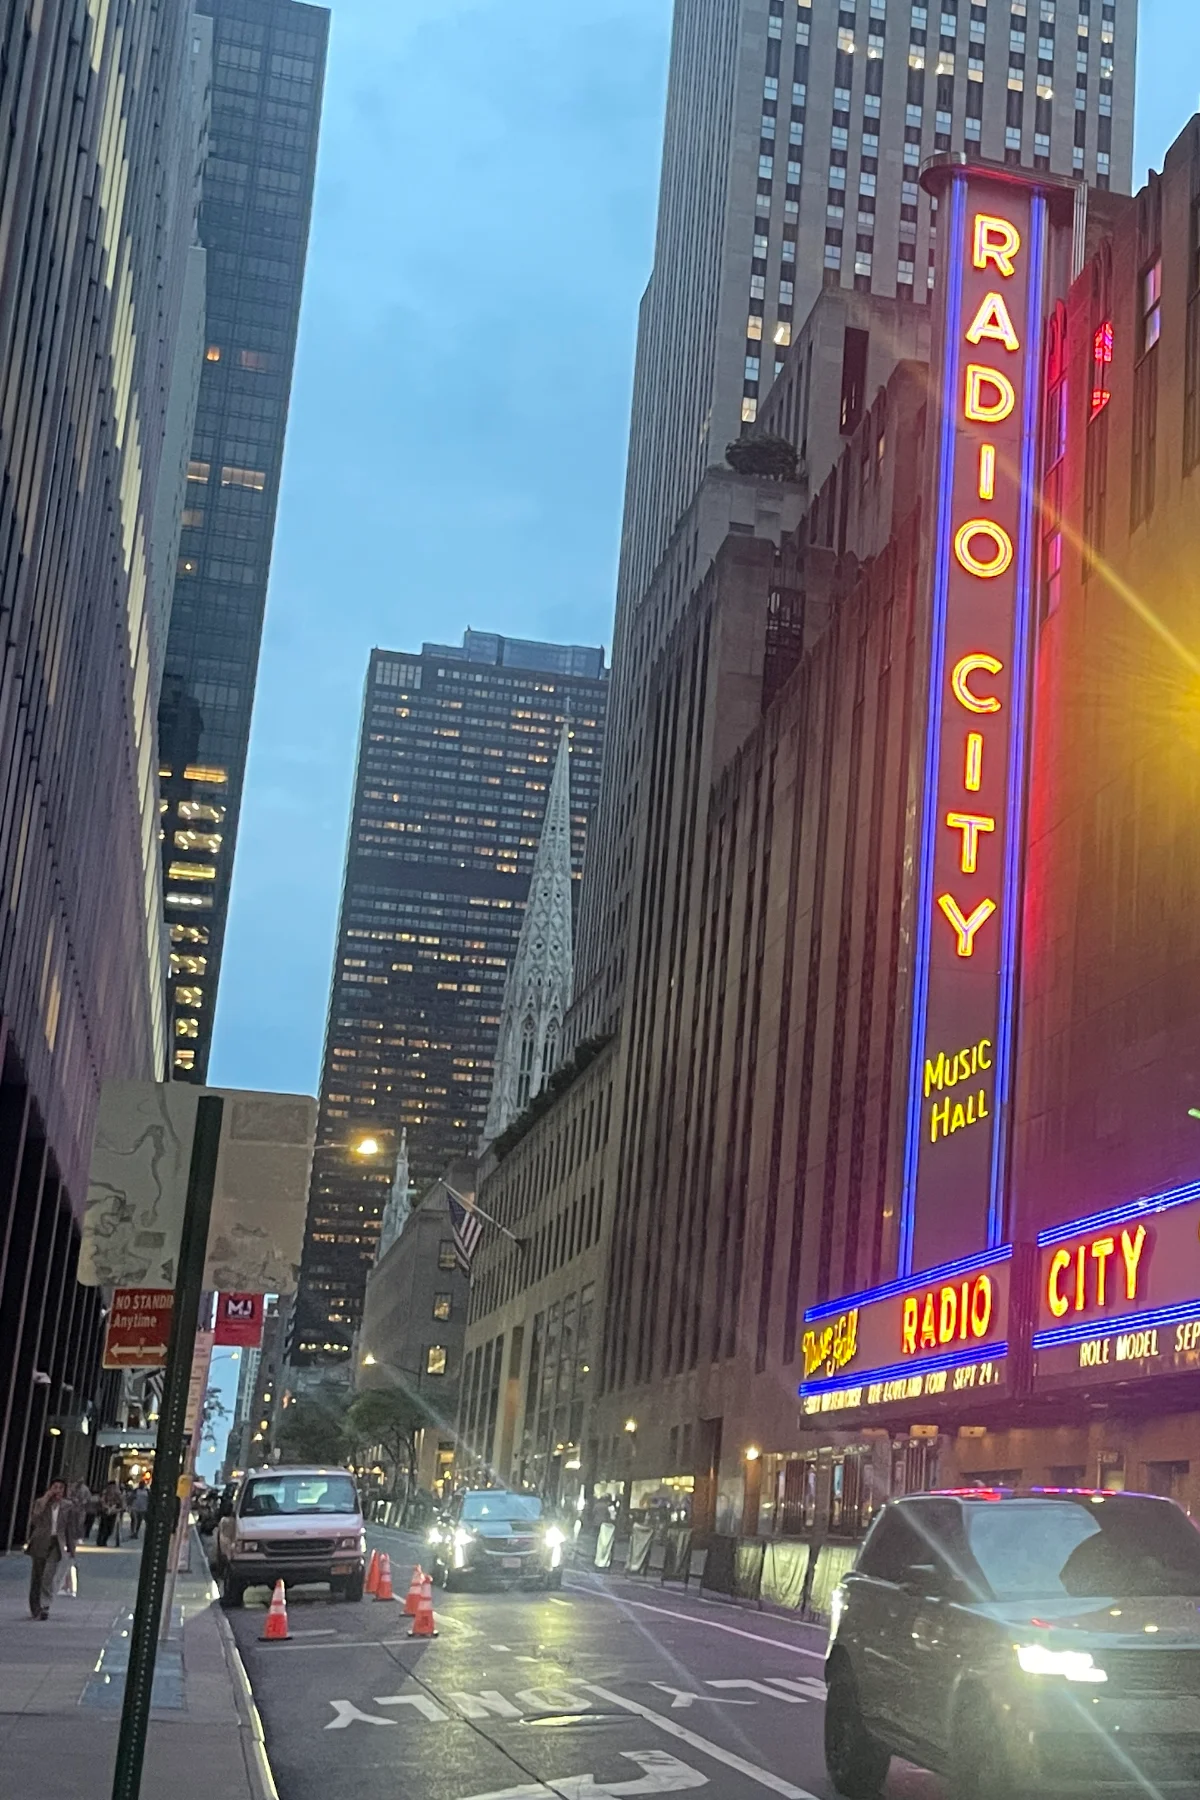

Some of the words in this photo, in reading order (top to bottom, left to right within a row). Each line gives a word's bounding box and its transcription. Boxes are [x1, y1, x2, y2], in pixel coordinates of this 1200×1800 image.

[954, 213, 1021, 578] RADIO
[937, 652, 1003, 957] CITY
[924, 1039, 992, 1098] MUSIC
[930, 1089, 989, 1143] HALL
[1048, 1224, 1148, 1318] CITY
[113, 1314, 157, 1330] Anytime
[116, 1296, 131, 1310] NO
[133, 1294, 174, 1310] STANDI
[228, 1299, 253, 1316] MJ
[902, 1274, 992, 1355] RADIO
[1079, 1339, 1110, 1367] ROLE
[1116, 1329, 1159, 1360] MODEL
[953, 1364, 977, 1390] SEPT
[978, 1362, 992, 1386] 24
[324, 1686, 593, 1730] ONLY
